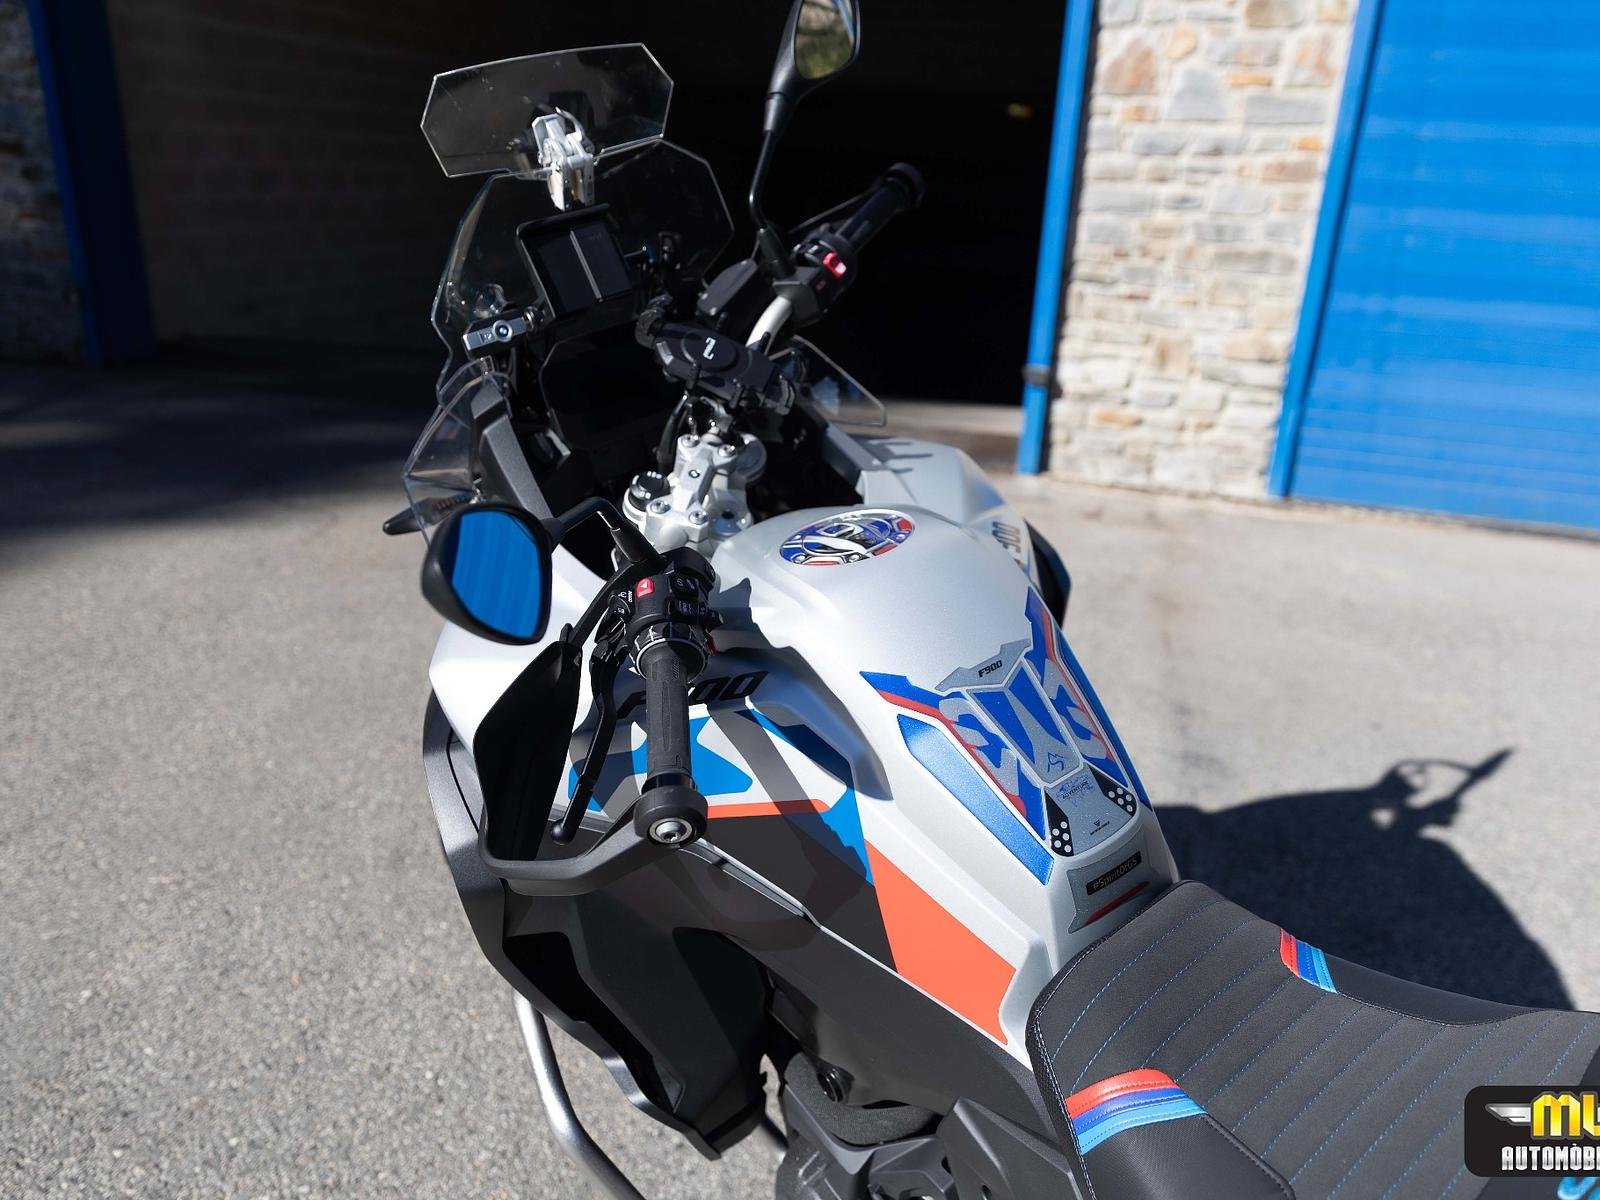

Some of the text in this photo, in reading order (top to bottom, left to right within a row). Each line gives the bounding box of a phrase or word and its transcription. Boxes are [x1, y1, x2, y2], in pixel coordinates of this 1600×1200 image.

[978, 660, 1002, 677] F900
[617, 670, 769, 719] F00
[1092, 856, 1137, 890] #SpiritOfGS
